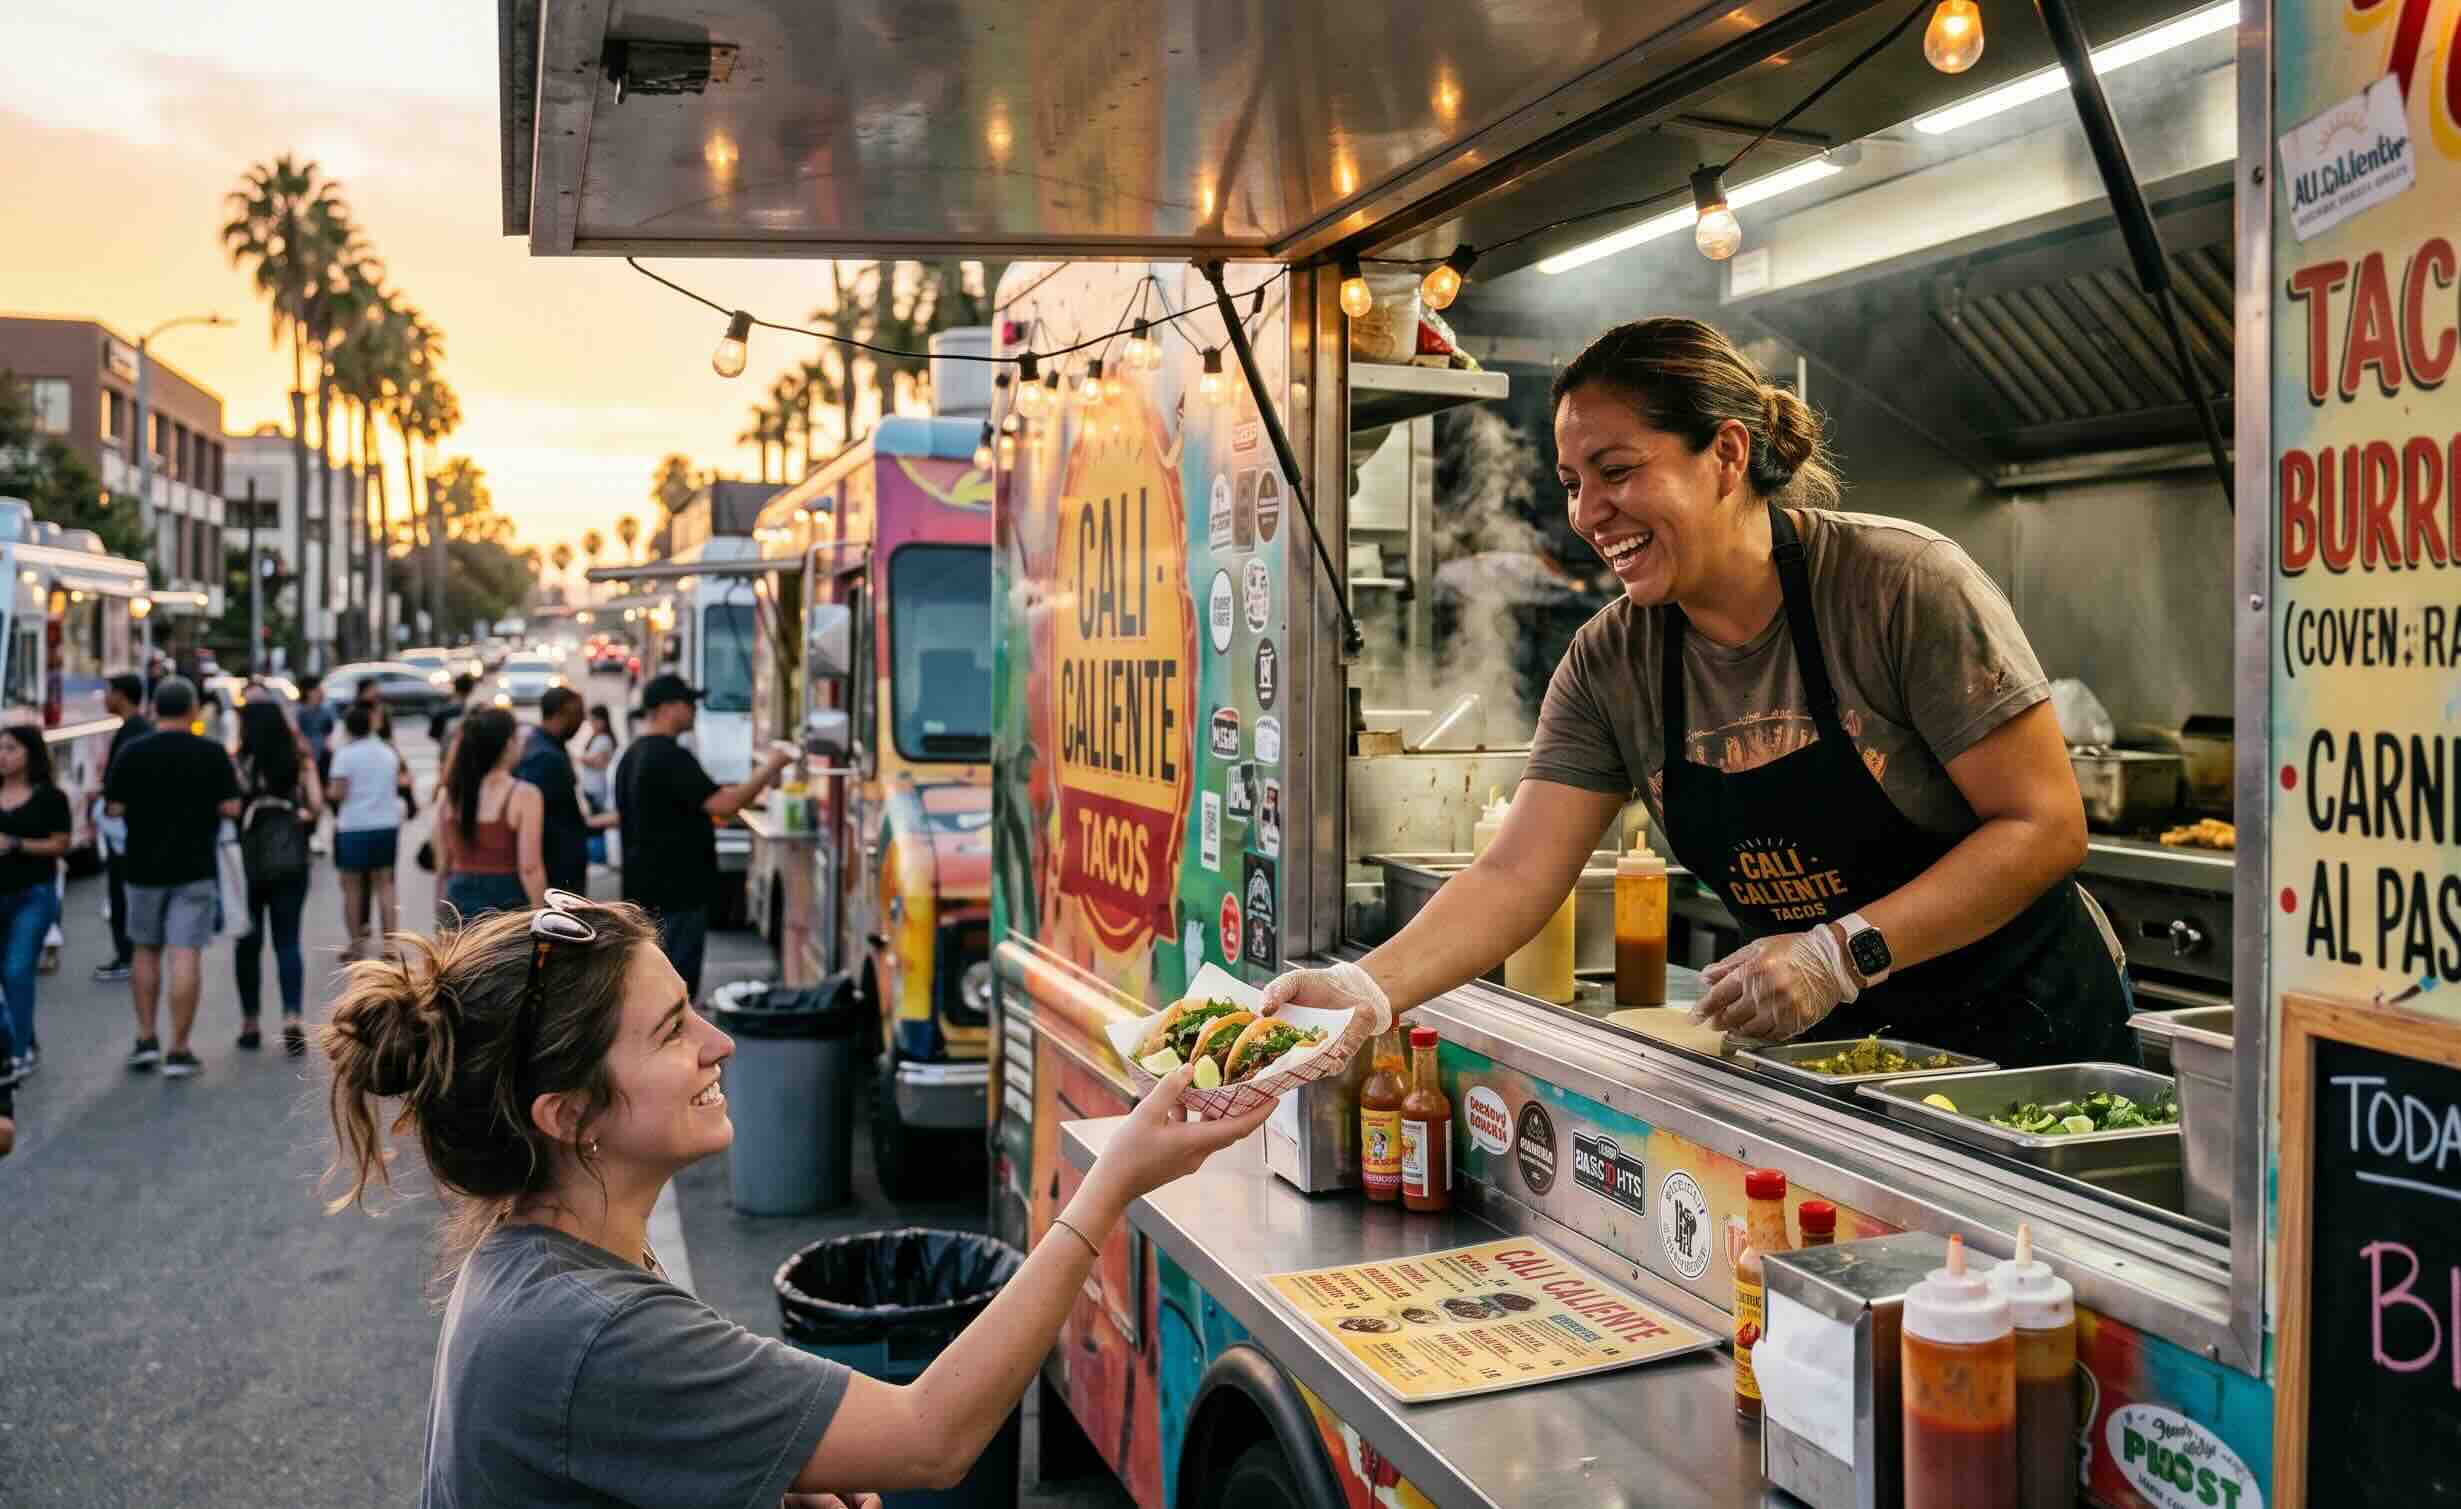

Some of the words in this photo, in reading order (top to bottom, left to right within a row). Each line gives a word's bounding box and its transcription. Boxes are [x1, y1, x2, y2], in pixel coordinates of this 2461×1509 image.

[1077, 486, 1149, 642] CALI
[1061, 658, 1177, 784] CALIENTE
[1078, 807, 1150, 897] TACOS
[1728, 868, 1849, 905] CALIENTE
[1738, 848, 1805, 881] CALI
[1769, 902, 1827, 921] TACOS
[2306, 859, 2363, 966] AL
[2377, 866, 2461, 983] PAS
[1494, 1249, 1567, 1281] CALI
[1541, 1279, 1671, 1343] CALIENTE
